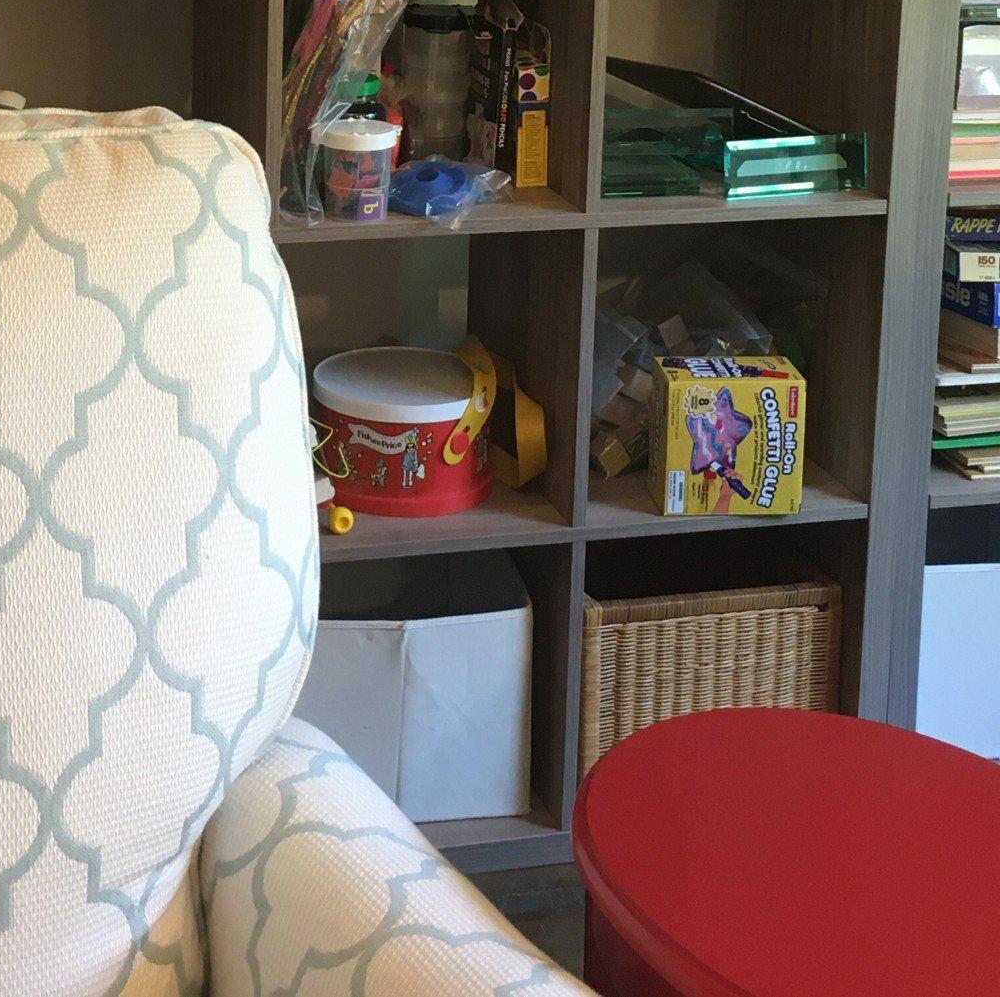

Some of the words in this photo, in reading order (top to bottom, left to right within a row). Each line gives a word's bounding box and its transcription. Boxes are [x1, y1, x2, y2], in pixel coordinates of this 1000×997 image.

[497, 123, 505, 148] PENCILS
[951, 216, 1000, 234] RAPPE
[978, 256, 996, 265] 150
[760, 387, 782, 463] CONFETTI
[357, 429, 402, 448] Fisher-Price
[757, 465, 779, 508] GLUE
